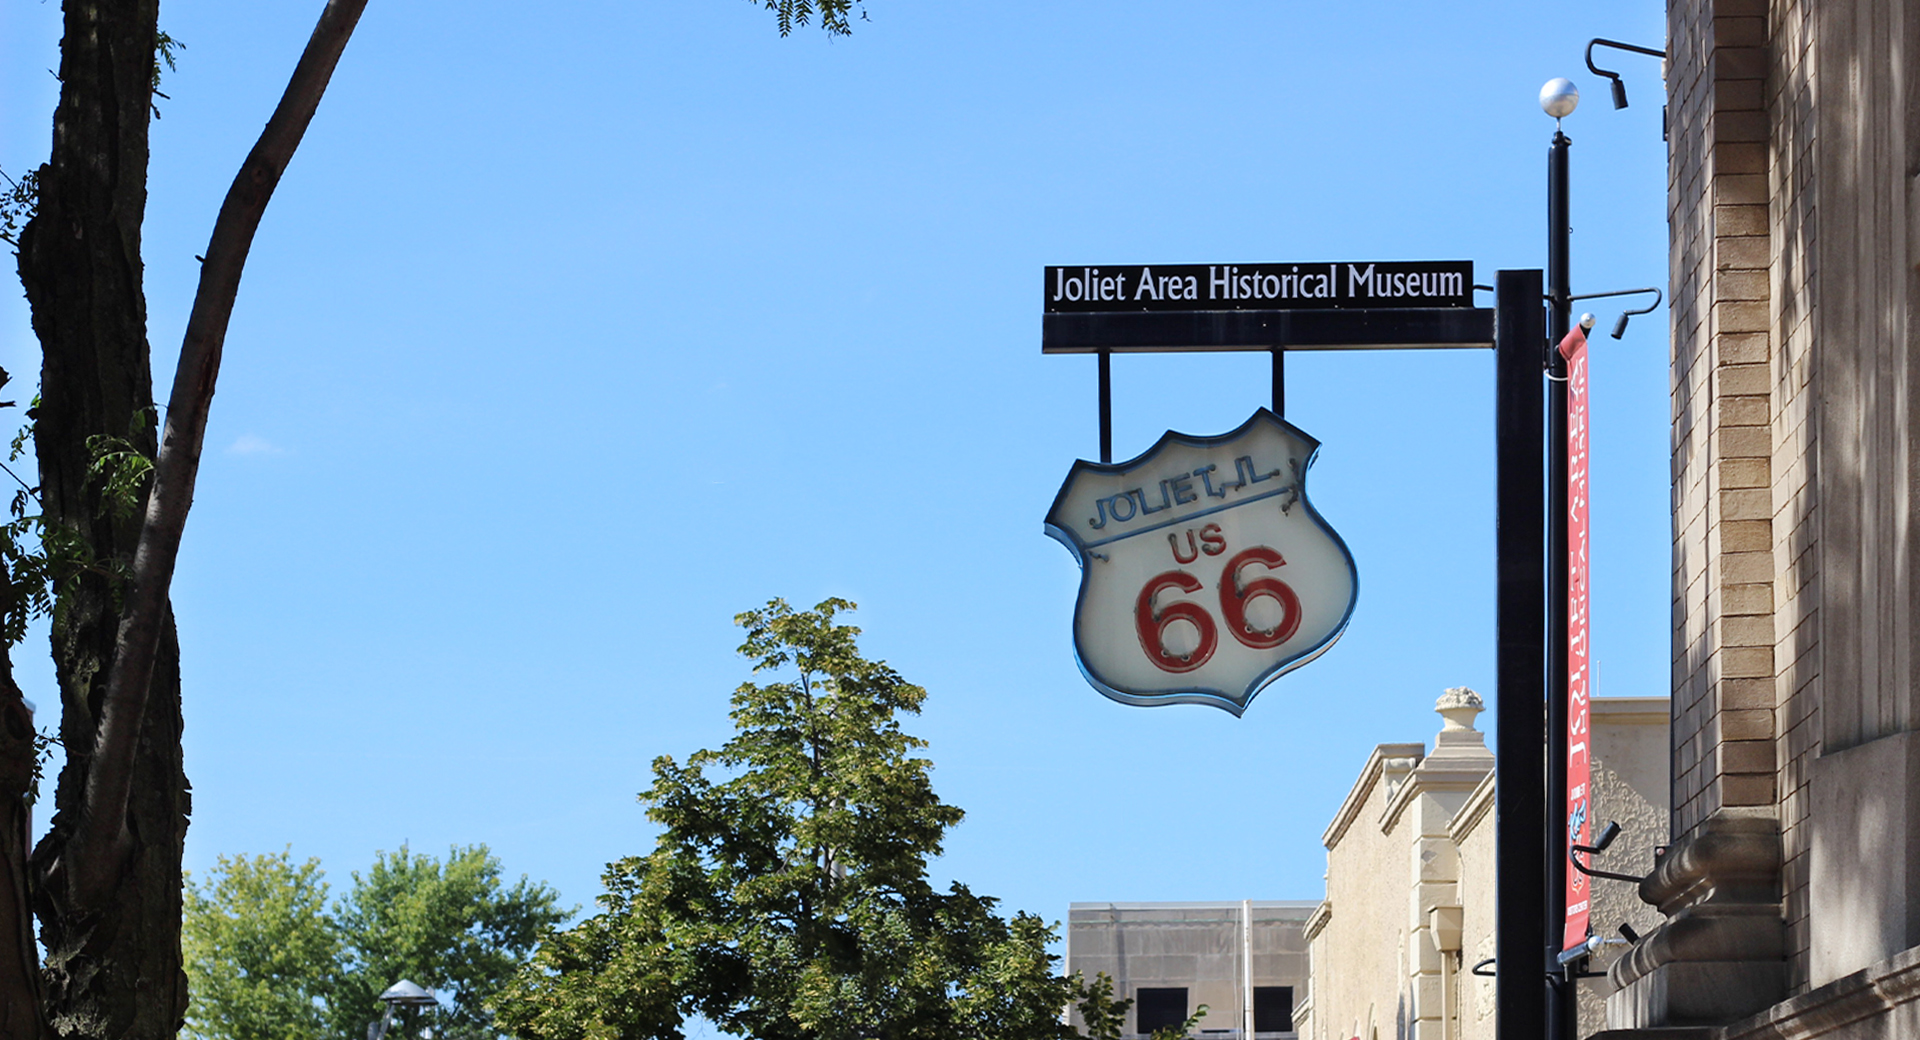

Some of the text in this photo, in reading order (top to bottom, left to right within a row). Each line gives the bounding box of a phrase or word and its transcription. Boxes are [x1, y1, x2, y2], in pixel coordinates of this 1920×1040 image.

[1053, 264, 1463, 302] Joliet Area Historical Museum
[1234, 455, 1280, 488] IL
[1167, 523, 1227, 565] US
[1135, 545, 1302, 674] 66
